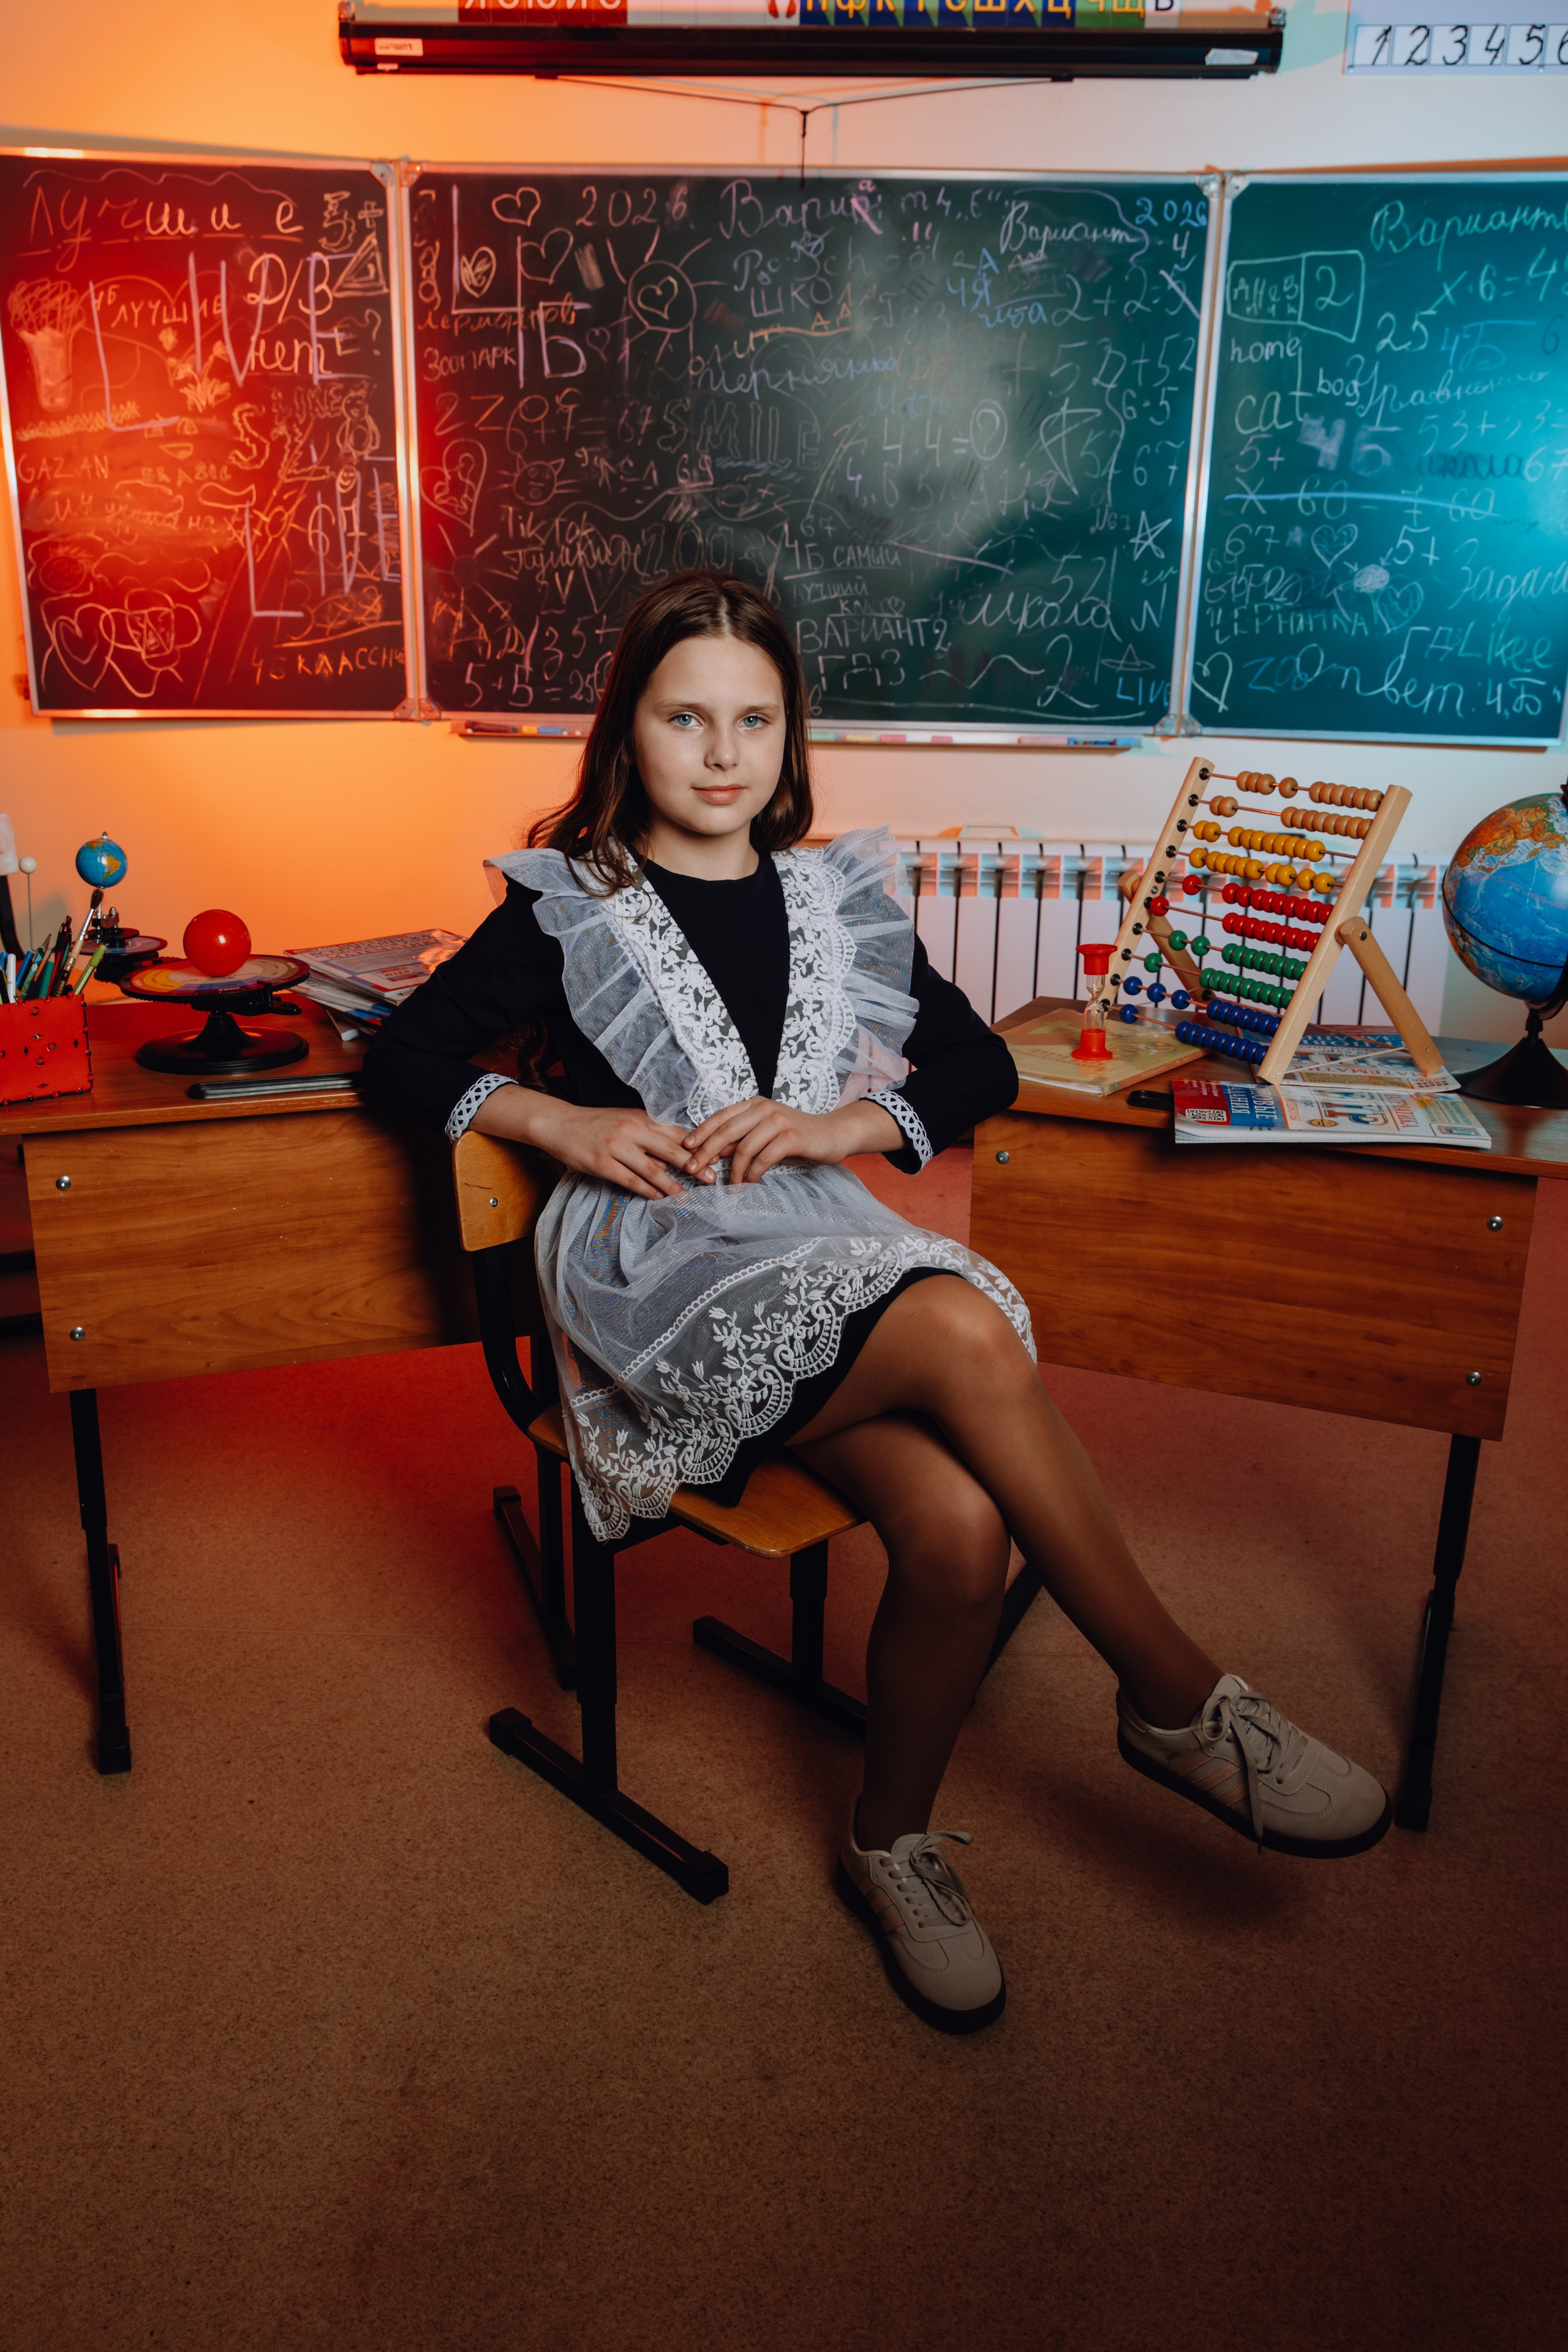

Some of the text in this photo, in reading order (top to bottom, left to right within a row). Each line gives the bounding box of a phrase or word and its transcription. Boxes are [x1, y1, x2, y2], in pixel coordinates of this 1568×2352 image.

[576, 185, 689, 227] 2026
[1000, 200, 1139, 255] Вариант
[1230, 337, 1301, 364] home
[796, 615, 931, 654] ВАРИАНТ
[1292, 1065, 1428, 1077] МАТЕМАТИК
